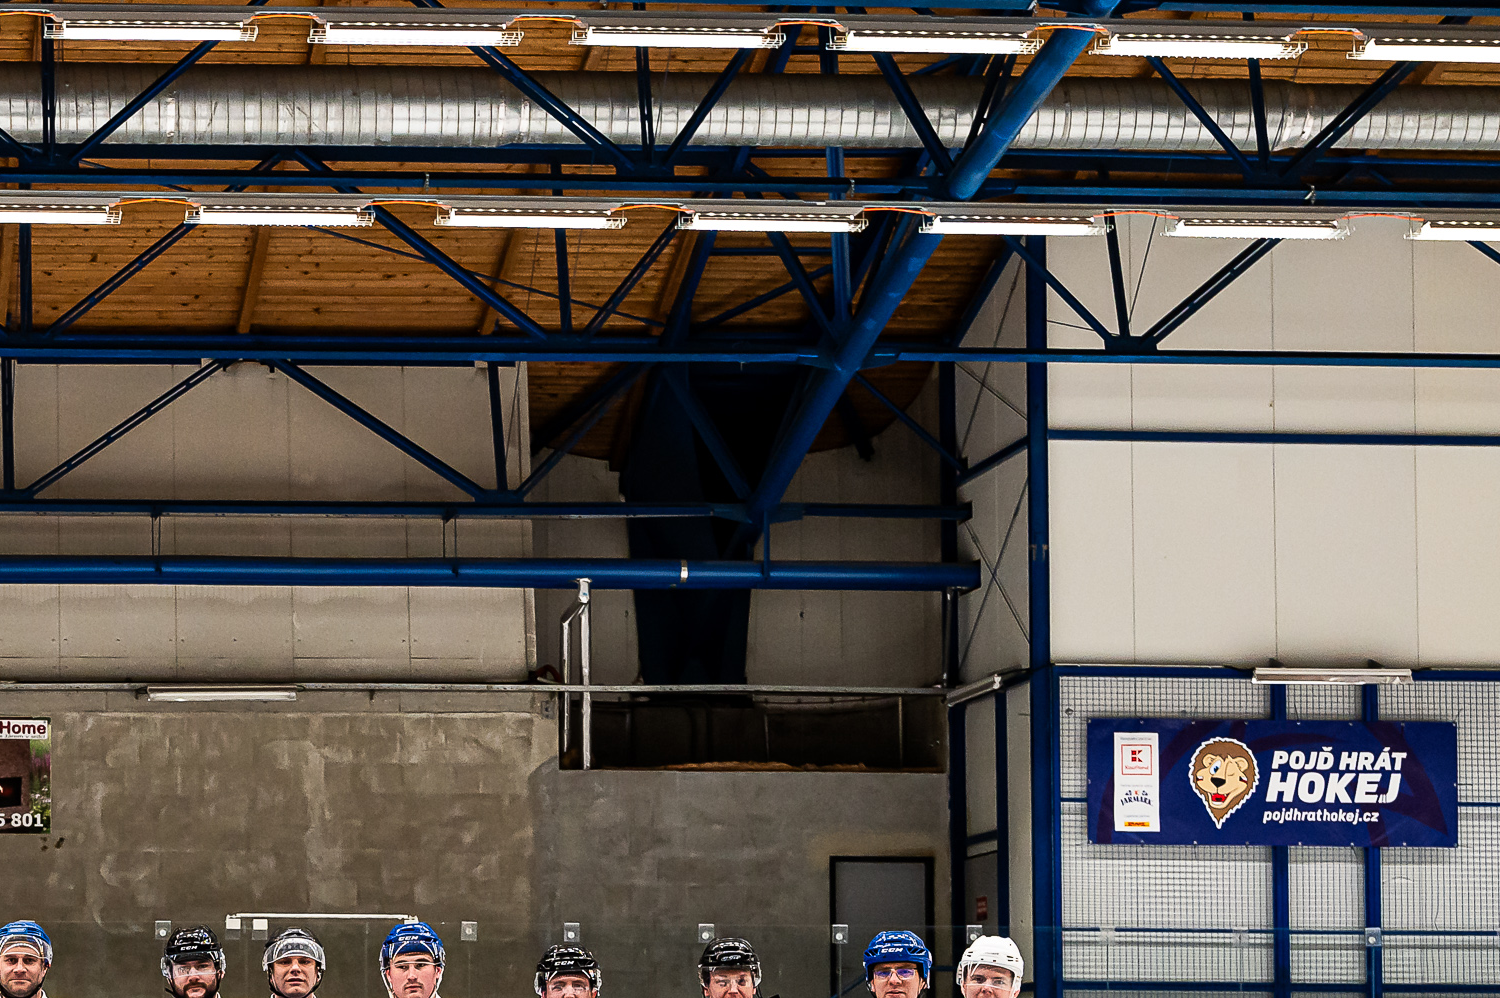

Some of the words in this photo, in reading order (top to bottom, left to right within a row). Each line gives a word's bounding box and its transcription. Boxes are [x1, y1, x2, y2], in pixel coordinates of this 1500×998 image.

[0, 720, 48, 736] Home
[1271, 746, 1335, 770] POJĎ
[1338, 746, 1407, 771] HRÁT
[1265, 772, 1401, 804] HOKEJ
[10, 812, 44, 828] 801
[1263, 808, 1380, 825] pojdhrathokej.cz
[881, 946, 904, 954] CCM
